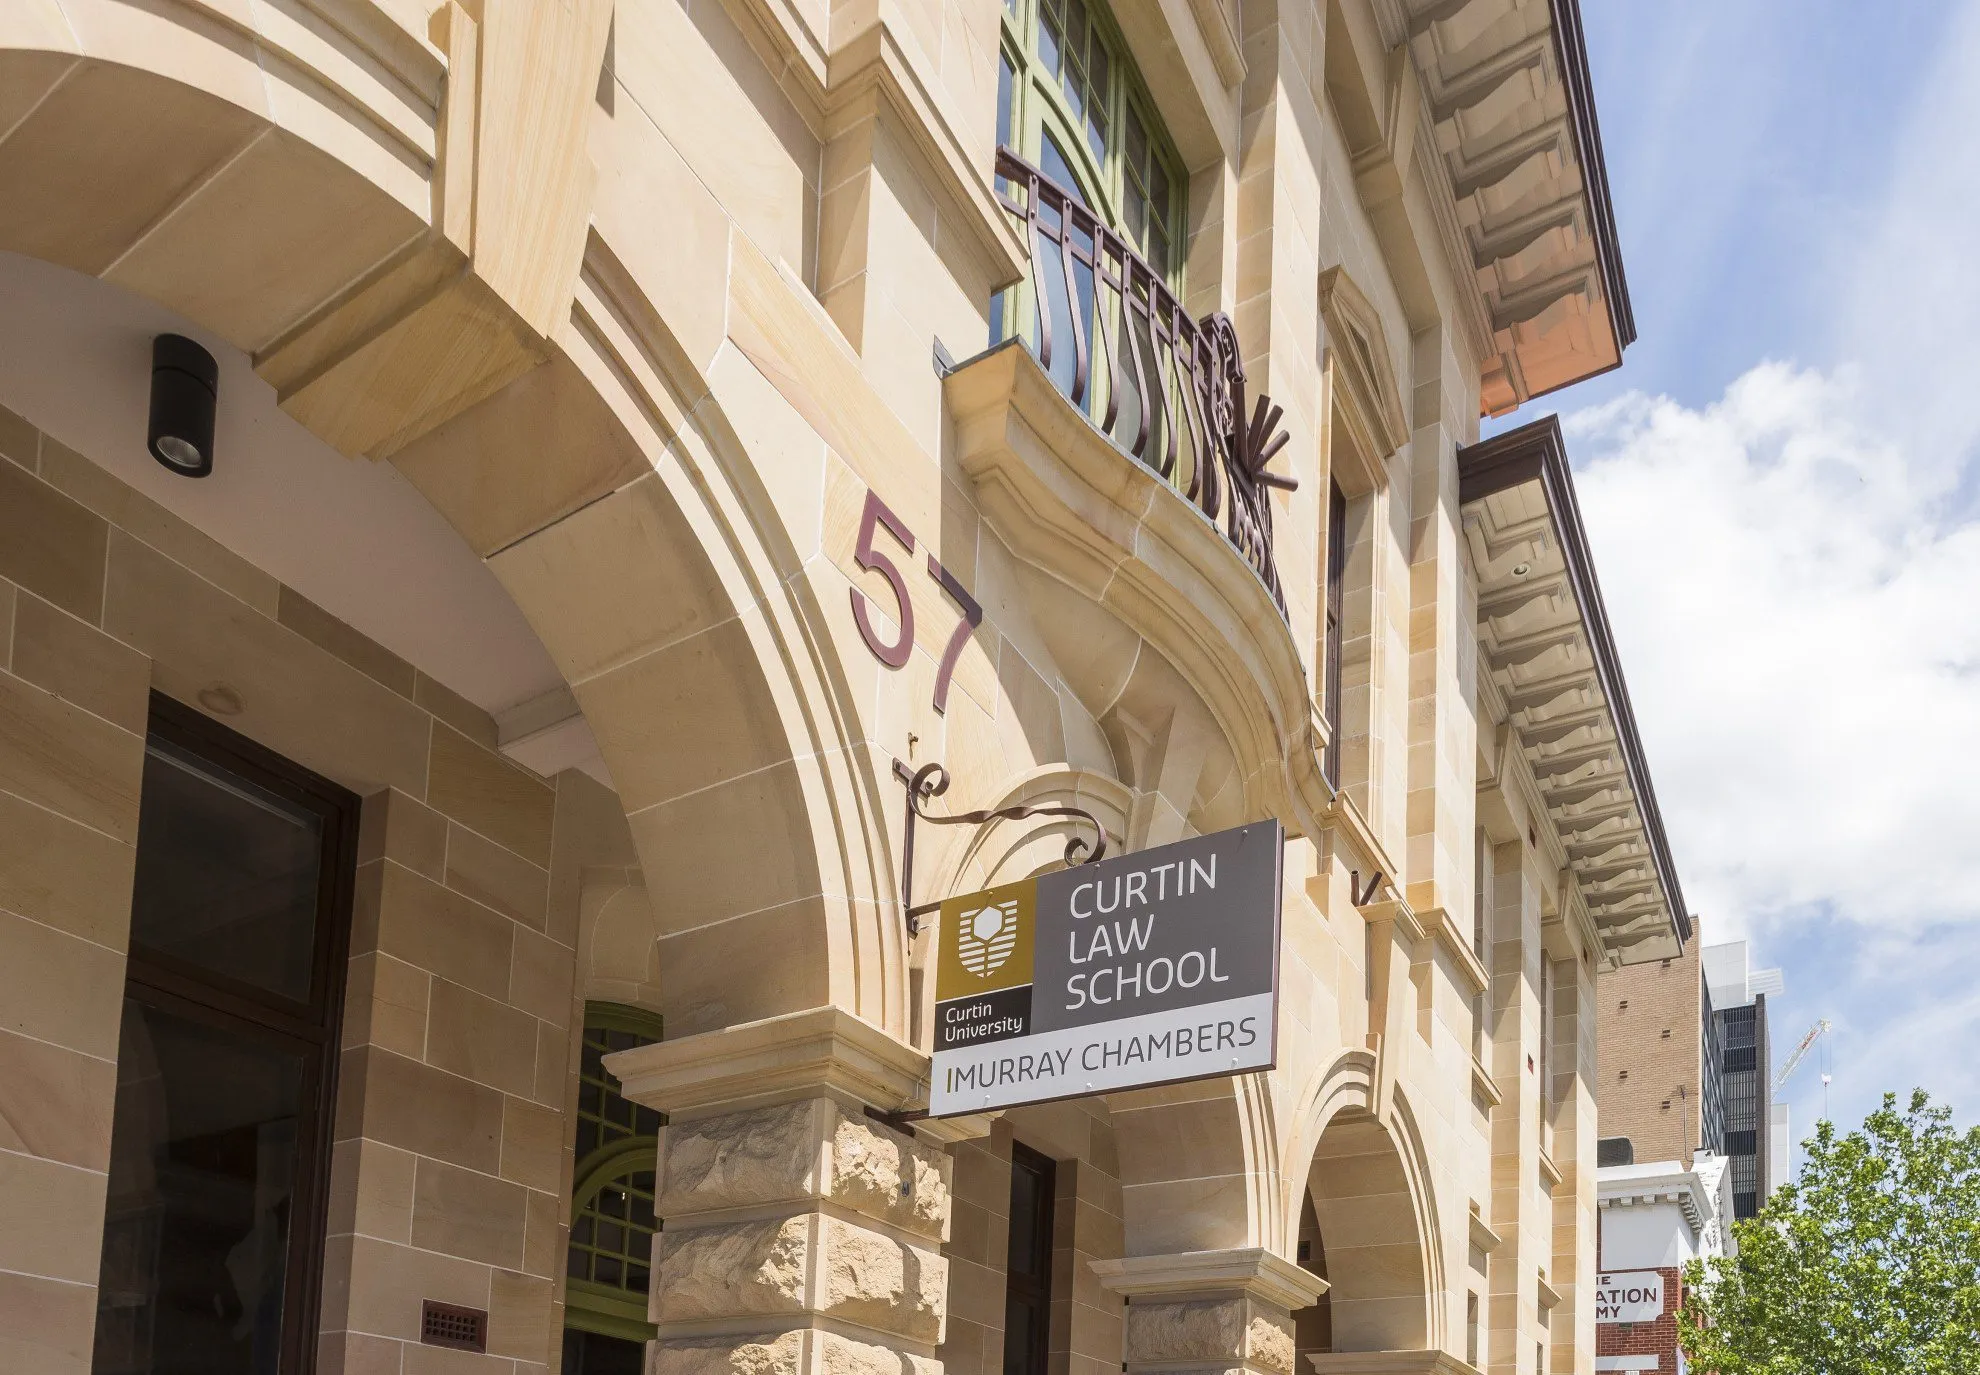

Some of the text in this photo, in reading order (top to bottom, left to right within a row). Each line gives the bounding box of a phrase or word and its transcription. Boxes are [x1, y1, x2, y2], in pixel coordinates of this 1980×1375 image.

[849, 488, 983, 718] 57
[1070, 853, 1217, 919] CURTIN
[1069, 914, 1155, 964] LAW
[1065, 947, 1230, 1010] SCHOOL
[945, 1016, 1023, 1042] University
[946, 1002, 992, 1023] Curtin
[1081, 1016, 1257, 1071] CHAMBERS
[1596, 1276, 1611, 1286] E
[1596, 1287, 1657, 1304] ATION
